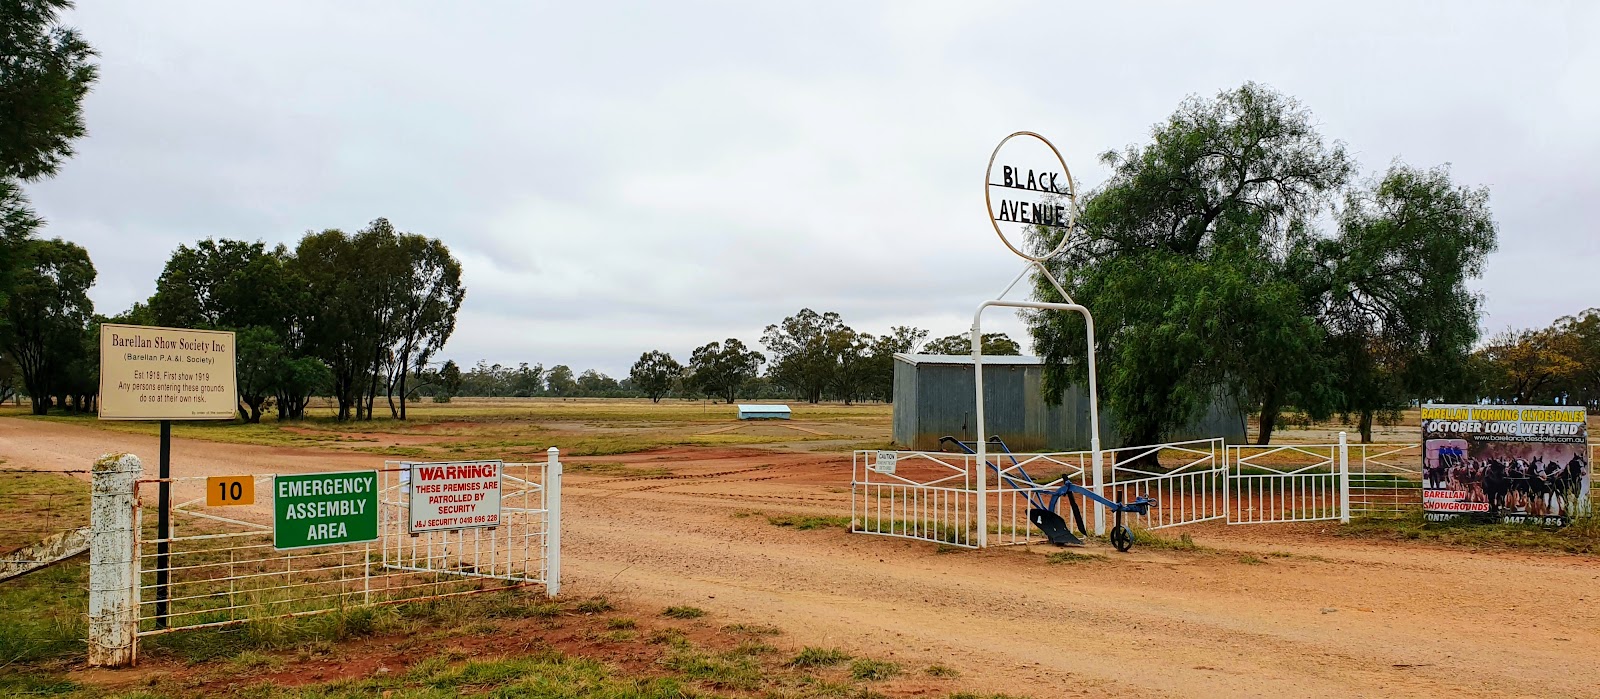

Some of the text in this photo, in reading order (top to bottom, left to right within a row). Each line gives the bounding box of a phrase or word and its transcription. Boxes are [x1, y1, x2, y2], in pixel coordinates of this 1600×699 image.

[1003, 165, 1060, 194] BLACK
[999, 199, 1065, 228] AVENUE
[112, 333, 226, 353] Barellan Show Society Inc
[123, 352, 158, 362] (Barellan
[186, 355, 215, 365] Society)
[134, 369, 144, 380] Est
[163, 371, 177, 380] First
[178, 371, 194, 381] show
[195, 372, 210, 382] 1919
[118, 381, 225, 394] Any persons entering these grounds
[139, 394, 147, 403] do
[148, 395, 156, 403] so
[156, 394, 164, 403] at
[164, 394, 178, 403] their
[179, 395, 192, 403] own
[1421, 408, 1585, 423] BARELLAN WORKING CLYDESDALES
[1429, 421, 1579, 435] OCTOBER LONG WEEKEND
[419, 464, 497, 481] WARNING!
[218, 481, 243, 501] 10
[279, 477, 373, 498] EMERGENCY
[416, 481, 498, 494] THESE PREMISES ARE
[1424, 490, 1465, 499] BARELLAN
[429, 492, 485, 505] PATROLLED BY
[285, 498, 367, 520] ASSEMBLY
[438, 504, 476, 515] SECURITY
[1424, 502, 1489, 512] SHOWGROUNDS
[414, 520, 427, 528] J&J
[428, 518, 458, 527] SECURITY
[487, 514, 498, 522] 228
[306, 521, 348, 541] AREA
